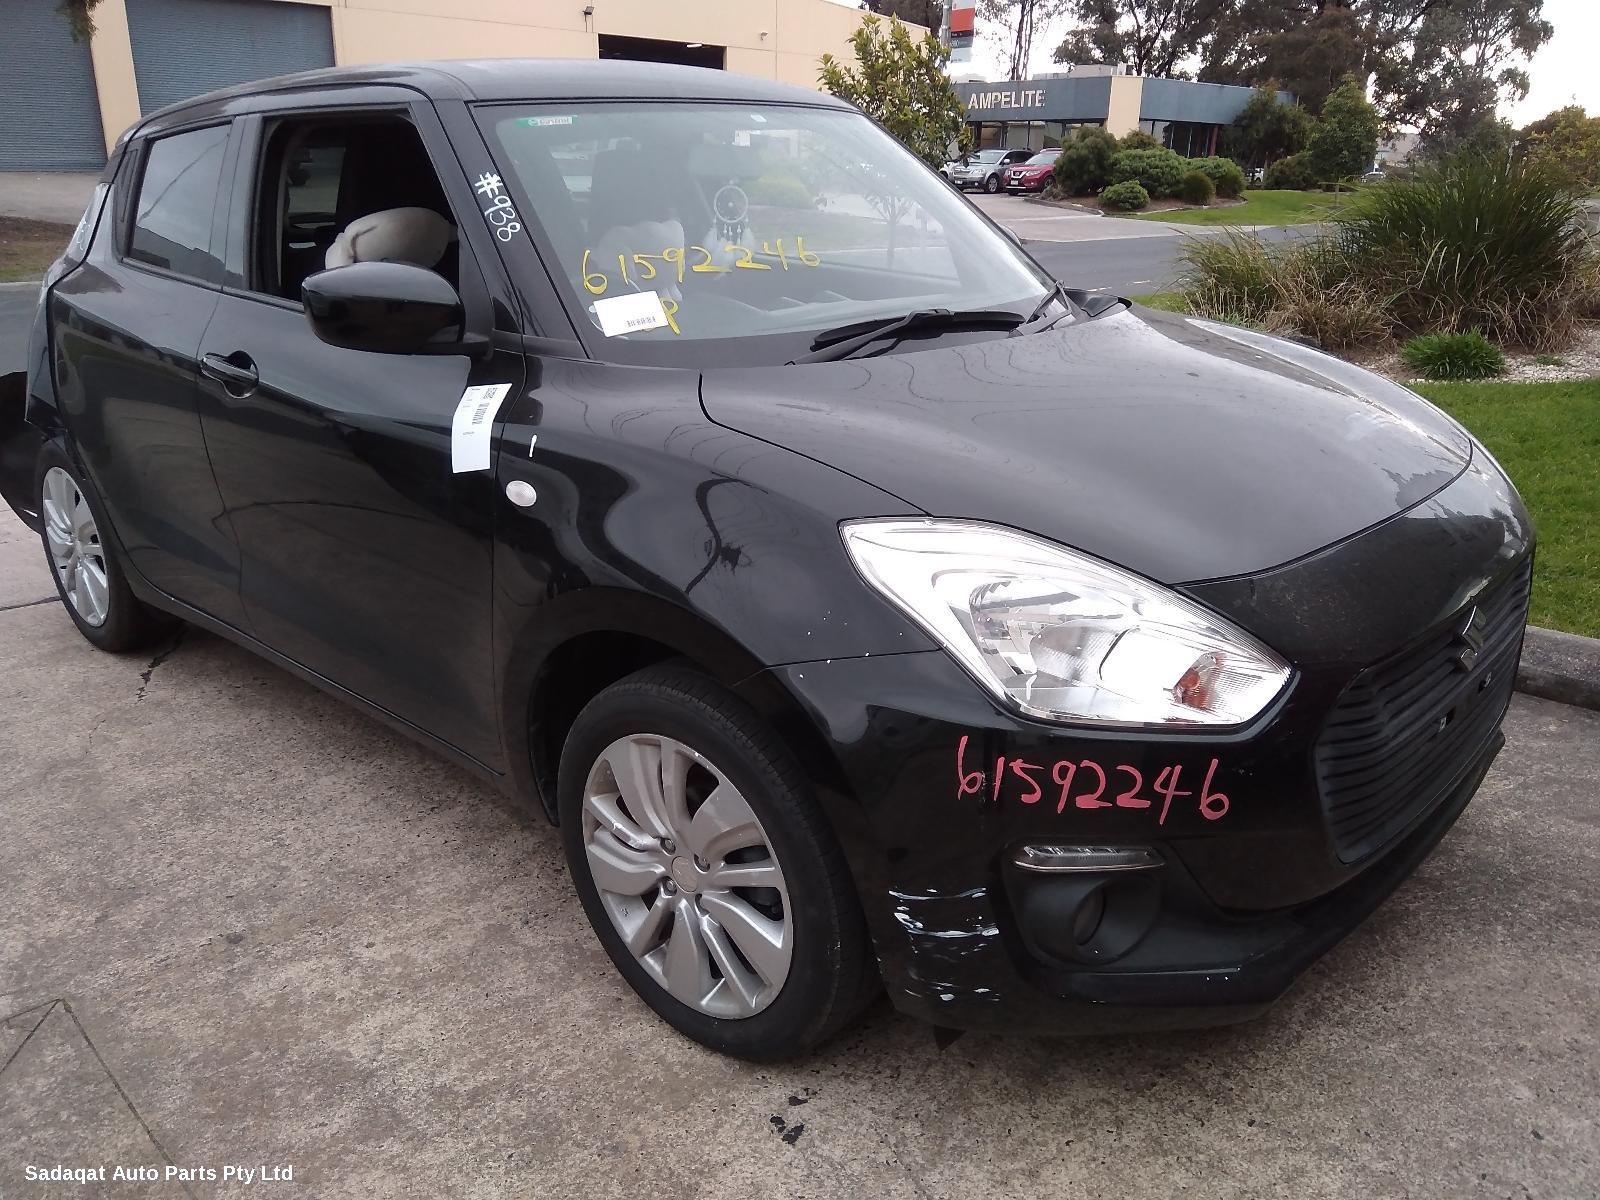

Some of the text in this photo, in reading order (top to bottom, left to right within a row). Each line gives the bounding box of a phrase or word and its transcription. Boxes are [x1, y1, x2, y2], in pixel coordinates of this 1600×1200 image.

[967, 90, 1045, 110] AMPELITE
[474, 171, 521, 242] #938
[582, 235, 821, 295] 61592246
[957, 735, 1230, 826] 61592246
